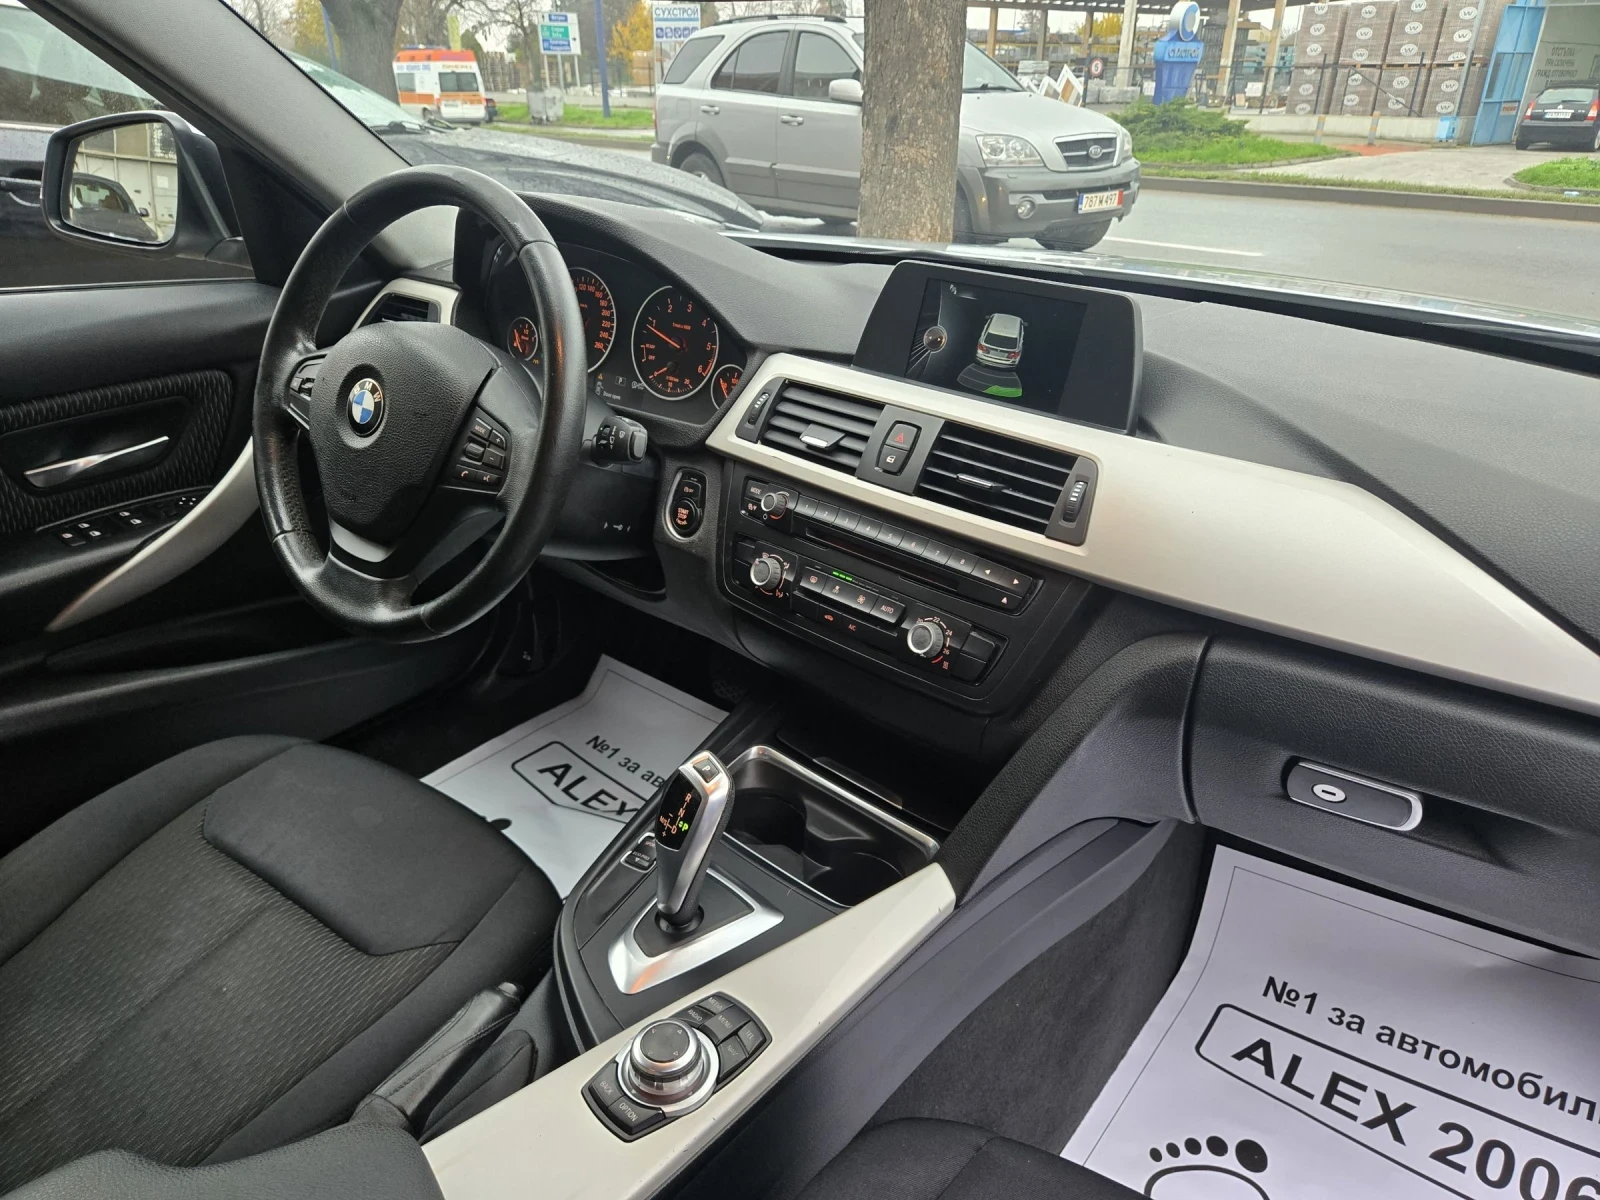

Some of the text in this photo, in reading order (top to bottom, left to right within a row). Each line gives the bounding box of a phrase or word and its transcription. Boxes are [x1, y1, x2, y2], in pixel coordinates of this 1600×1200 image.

[654, 5, 699, 17] СУХСТРОЙ
[667, 304, 673, 313] 2
[686, 304, 693, 313] 3
[652, 319, 656, 327] 1
[701, 319, 707, 328] 4
[706, 342, 711, 351] 5
[697, 365, 703, 373] 6
[353, 381, 383, 403] BMW
[474, 424, 487, 435] MODE
[880, 604, 894, 614] AUTO
[942, 648, 950, 656] 26
[586, 735, 621, 759] №1
[617, 757, 641, 774] за
[536, 763, 640, 817] ALEX
[685, 793, 692, 803] R
[678, 807, 686, 818] N
[708, 997, 723, 1010] MEDIA
[687, 1009, 703, 1022] RADIO
[717, 1014, 733, 1029] MENU
[726, 1044, 738, 1056] NAV
[1261, 975, 1600, 1125] №1 за автомобил
[599, 1080, 613, 1095] BACK
[1230, 1037, 1417, 1147] ALEX
[618, 1102, 638, 1122] OPTION
